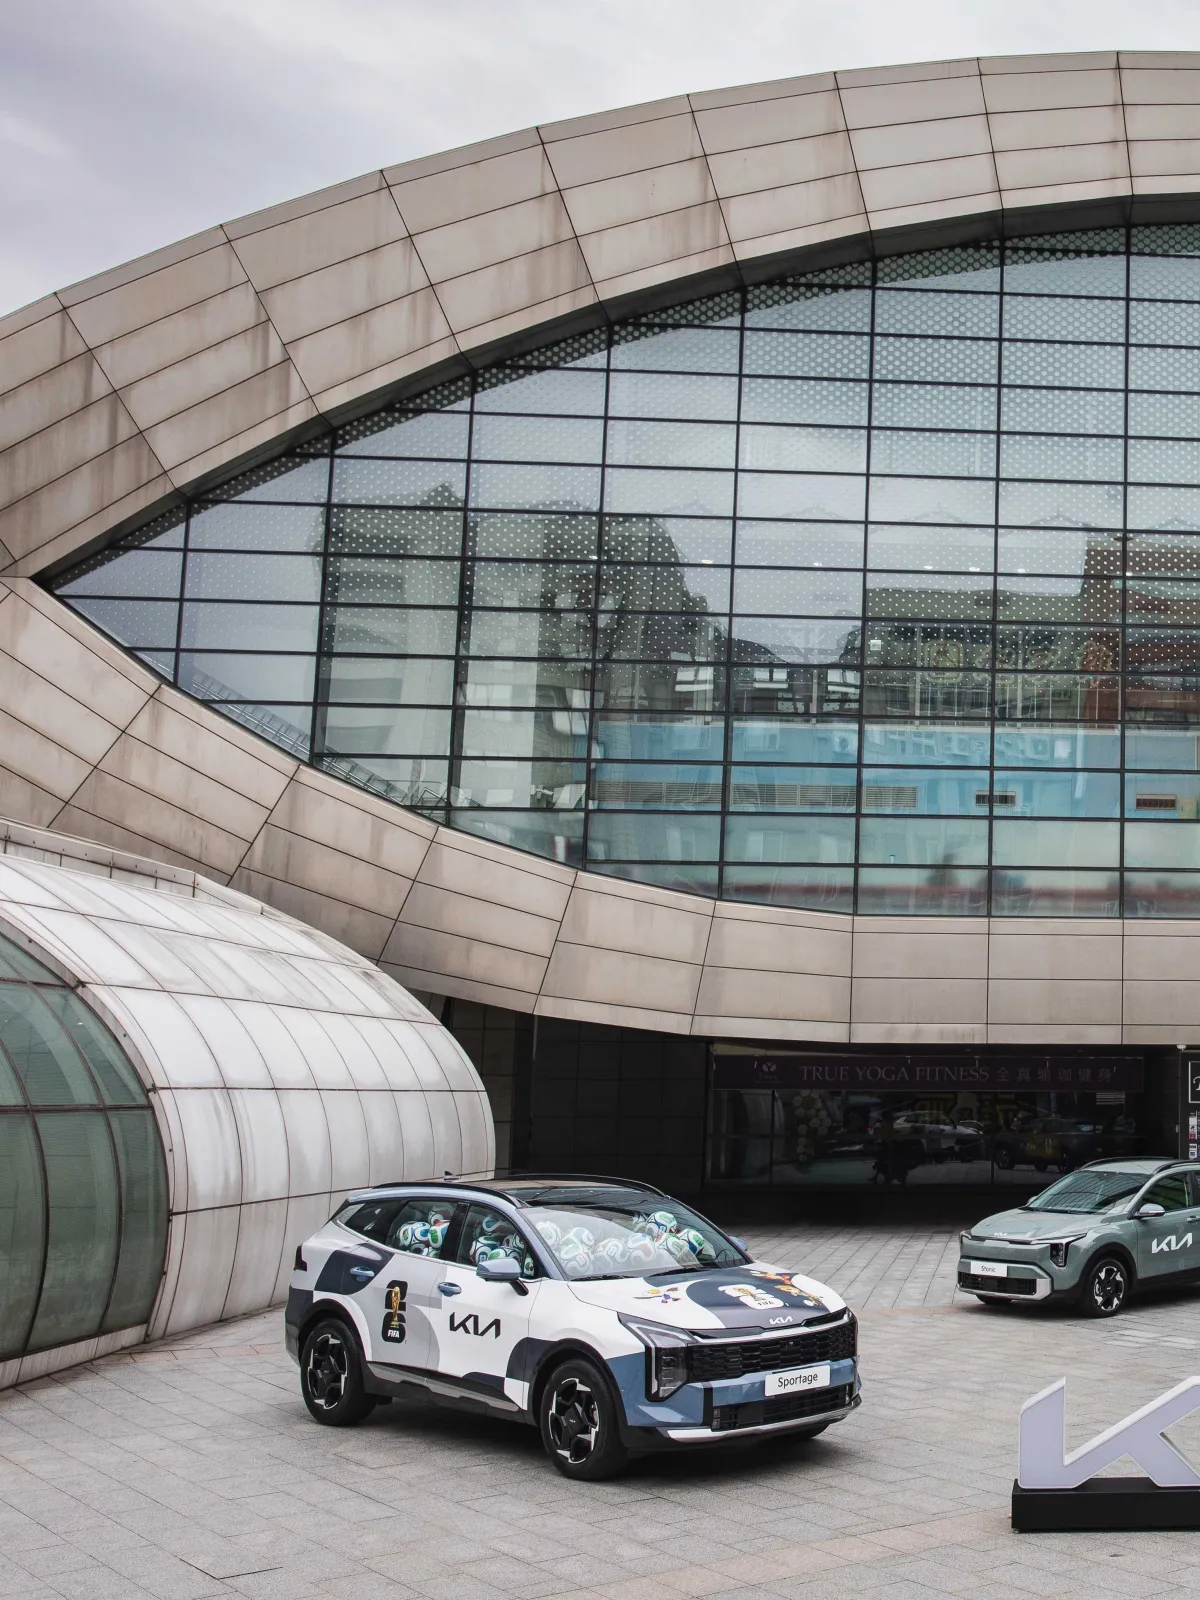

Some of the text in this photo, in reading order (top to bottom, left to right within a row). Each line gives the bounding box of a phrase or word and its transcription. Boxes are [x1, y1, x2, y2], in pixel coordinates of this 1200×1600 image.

[798, 1065, 990, 1082] TRUE YOGA FITNESS
[1151, 1231, 1193, 1254] KIA
[387, 1329, 400, 1339] FIFA
[449, 1311, 501, 1340] KIA
[777, 1372, 818, 1389] Sportage
